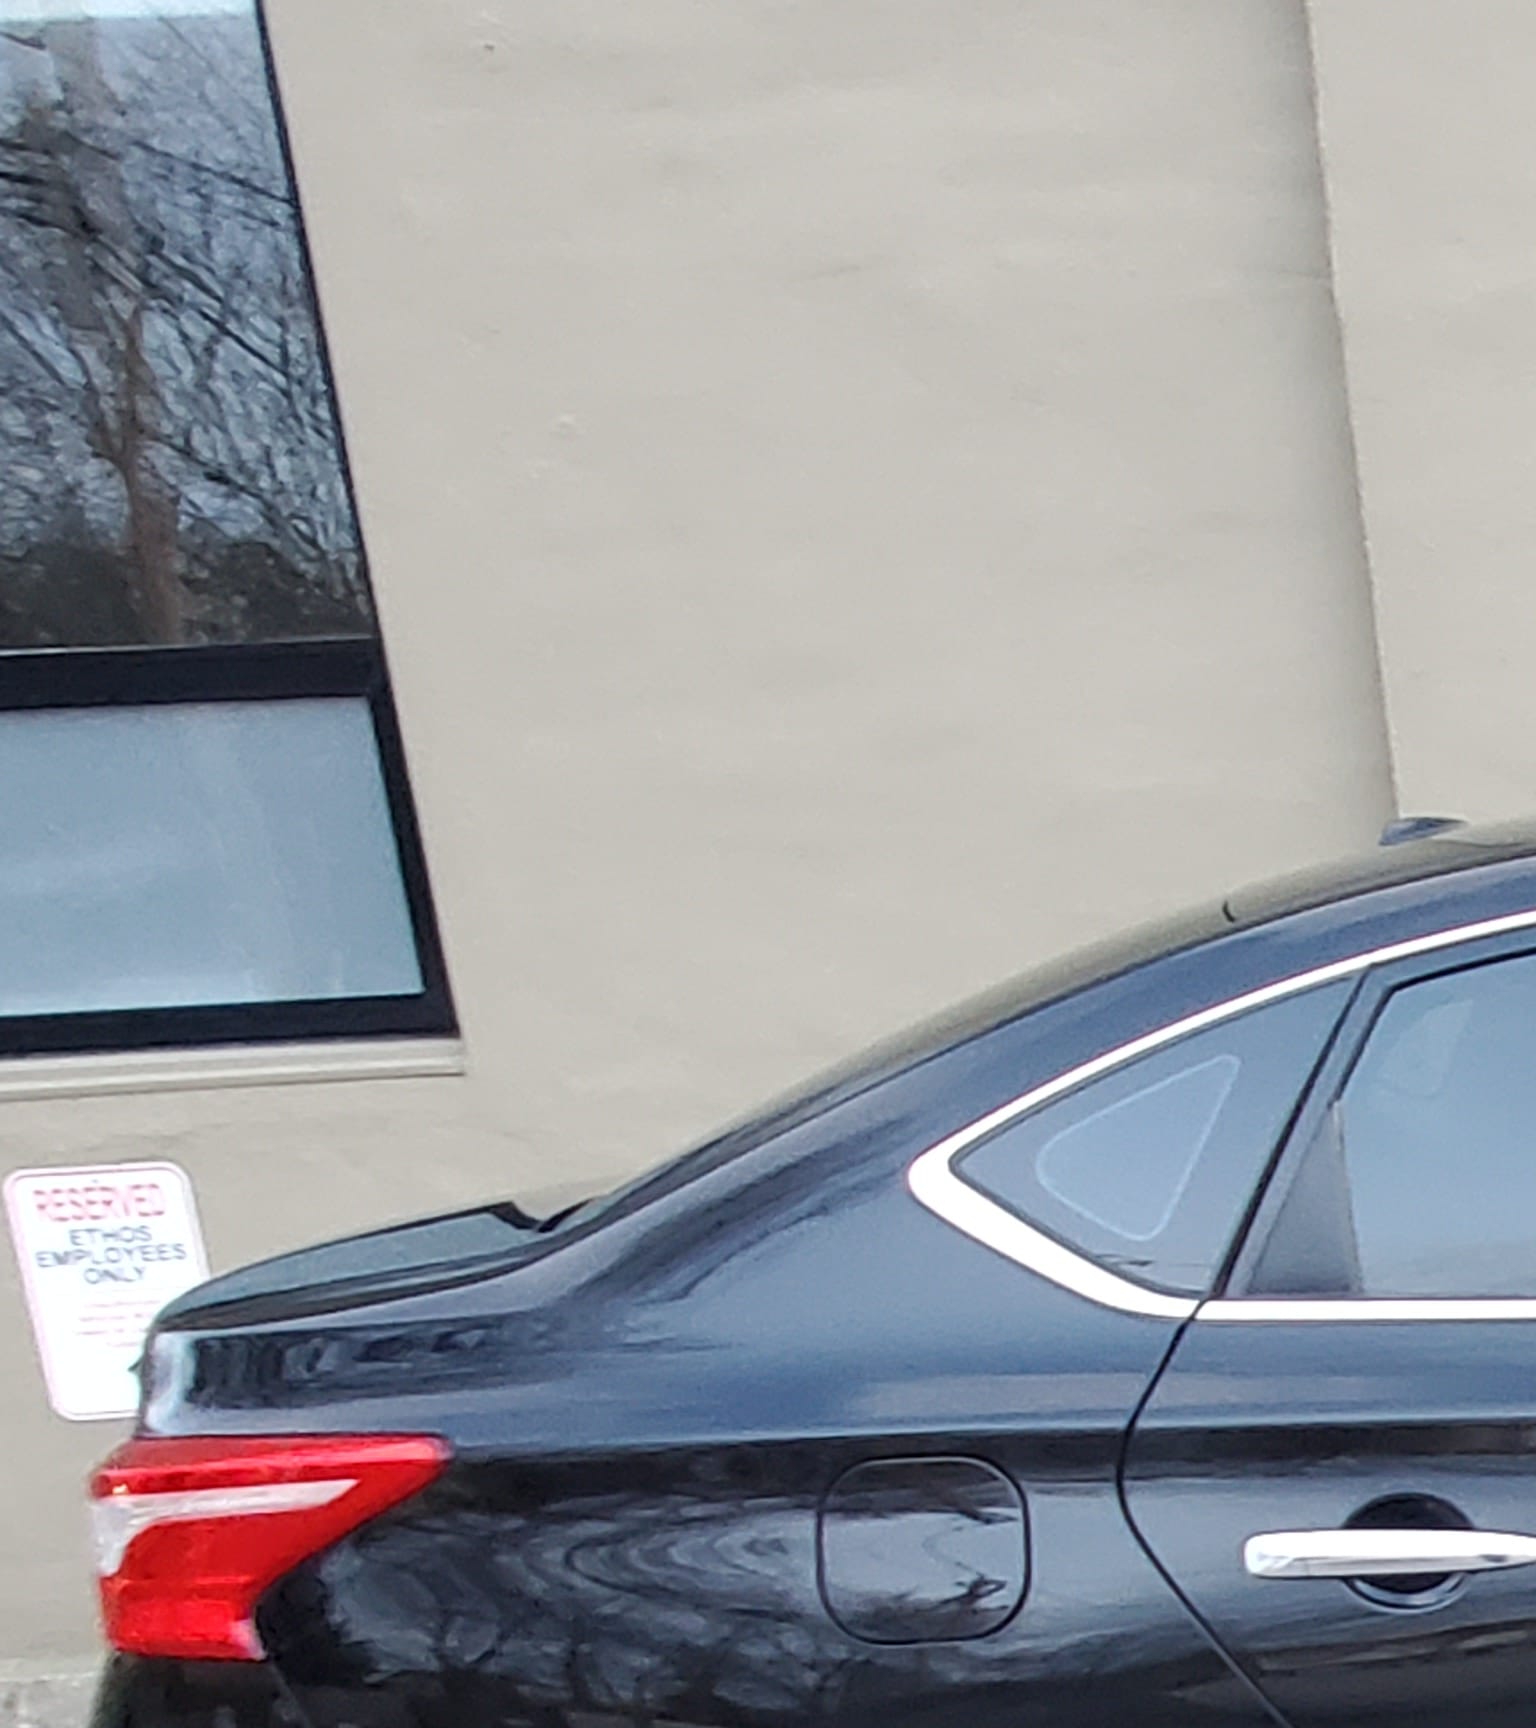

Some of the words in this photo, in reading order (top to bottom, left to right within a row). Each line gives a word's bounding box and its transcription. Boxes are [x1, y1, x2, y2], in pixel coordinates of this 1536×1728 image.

[69, 1226, 151, 1246] ETHOS
[36, 1244, 187, 1268] EMPLOYEES
[84, 1266, 144, 1284] ONLY
